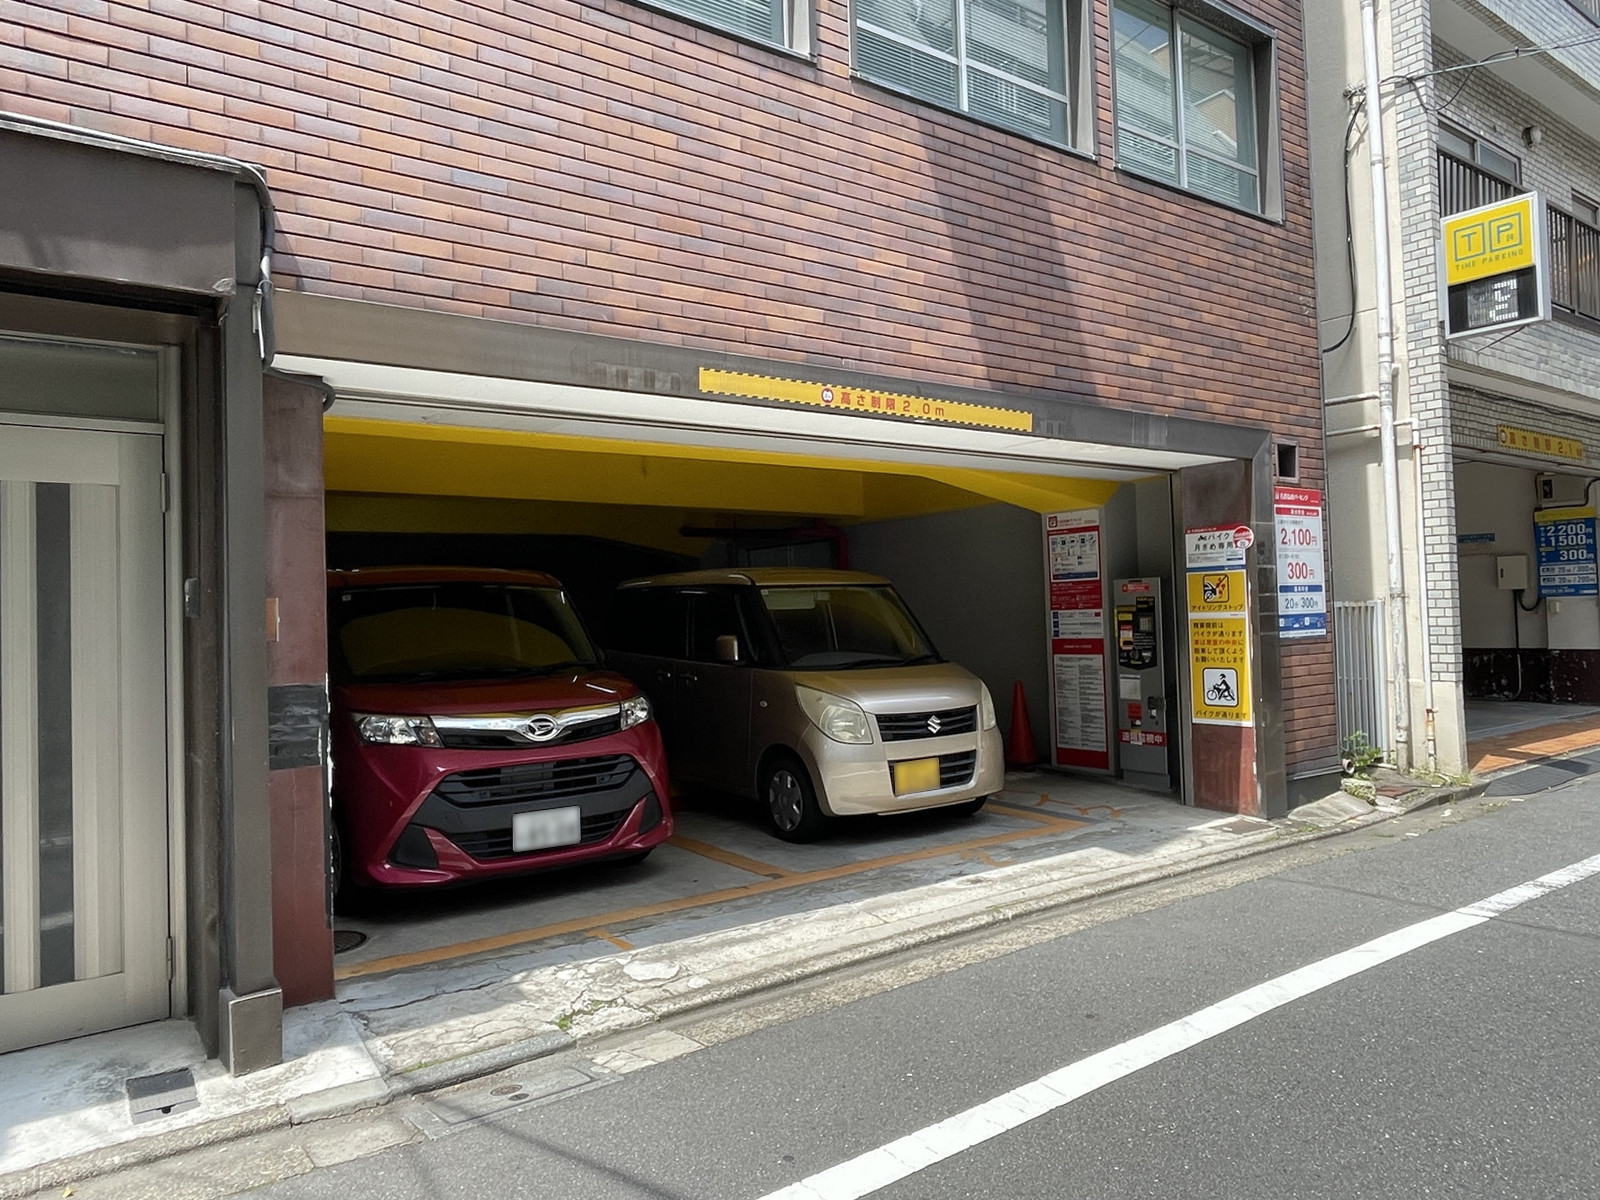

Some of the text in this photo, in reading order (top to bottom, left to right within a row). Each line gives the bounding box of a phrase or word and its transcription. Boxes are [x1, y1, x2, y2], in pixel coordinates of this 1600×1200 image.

[1455, 249, 1524, 271] TIME PARKING
[1207, 532, 1230, 540] バイク
[1280, 528, 1318, 547] 2,100円
[1559, 549, 1595, 561] 300円
[1287, 562, 1315, 580] 300円
[1195, 709, 1247, 719] バイクが通ります
